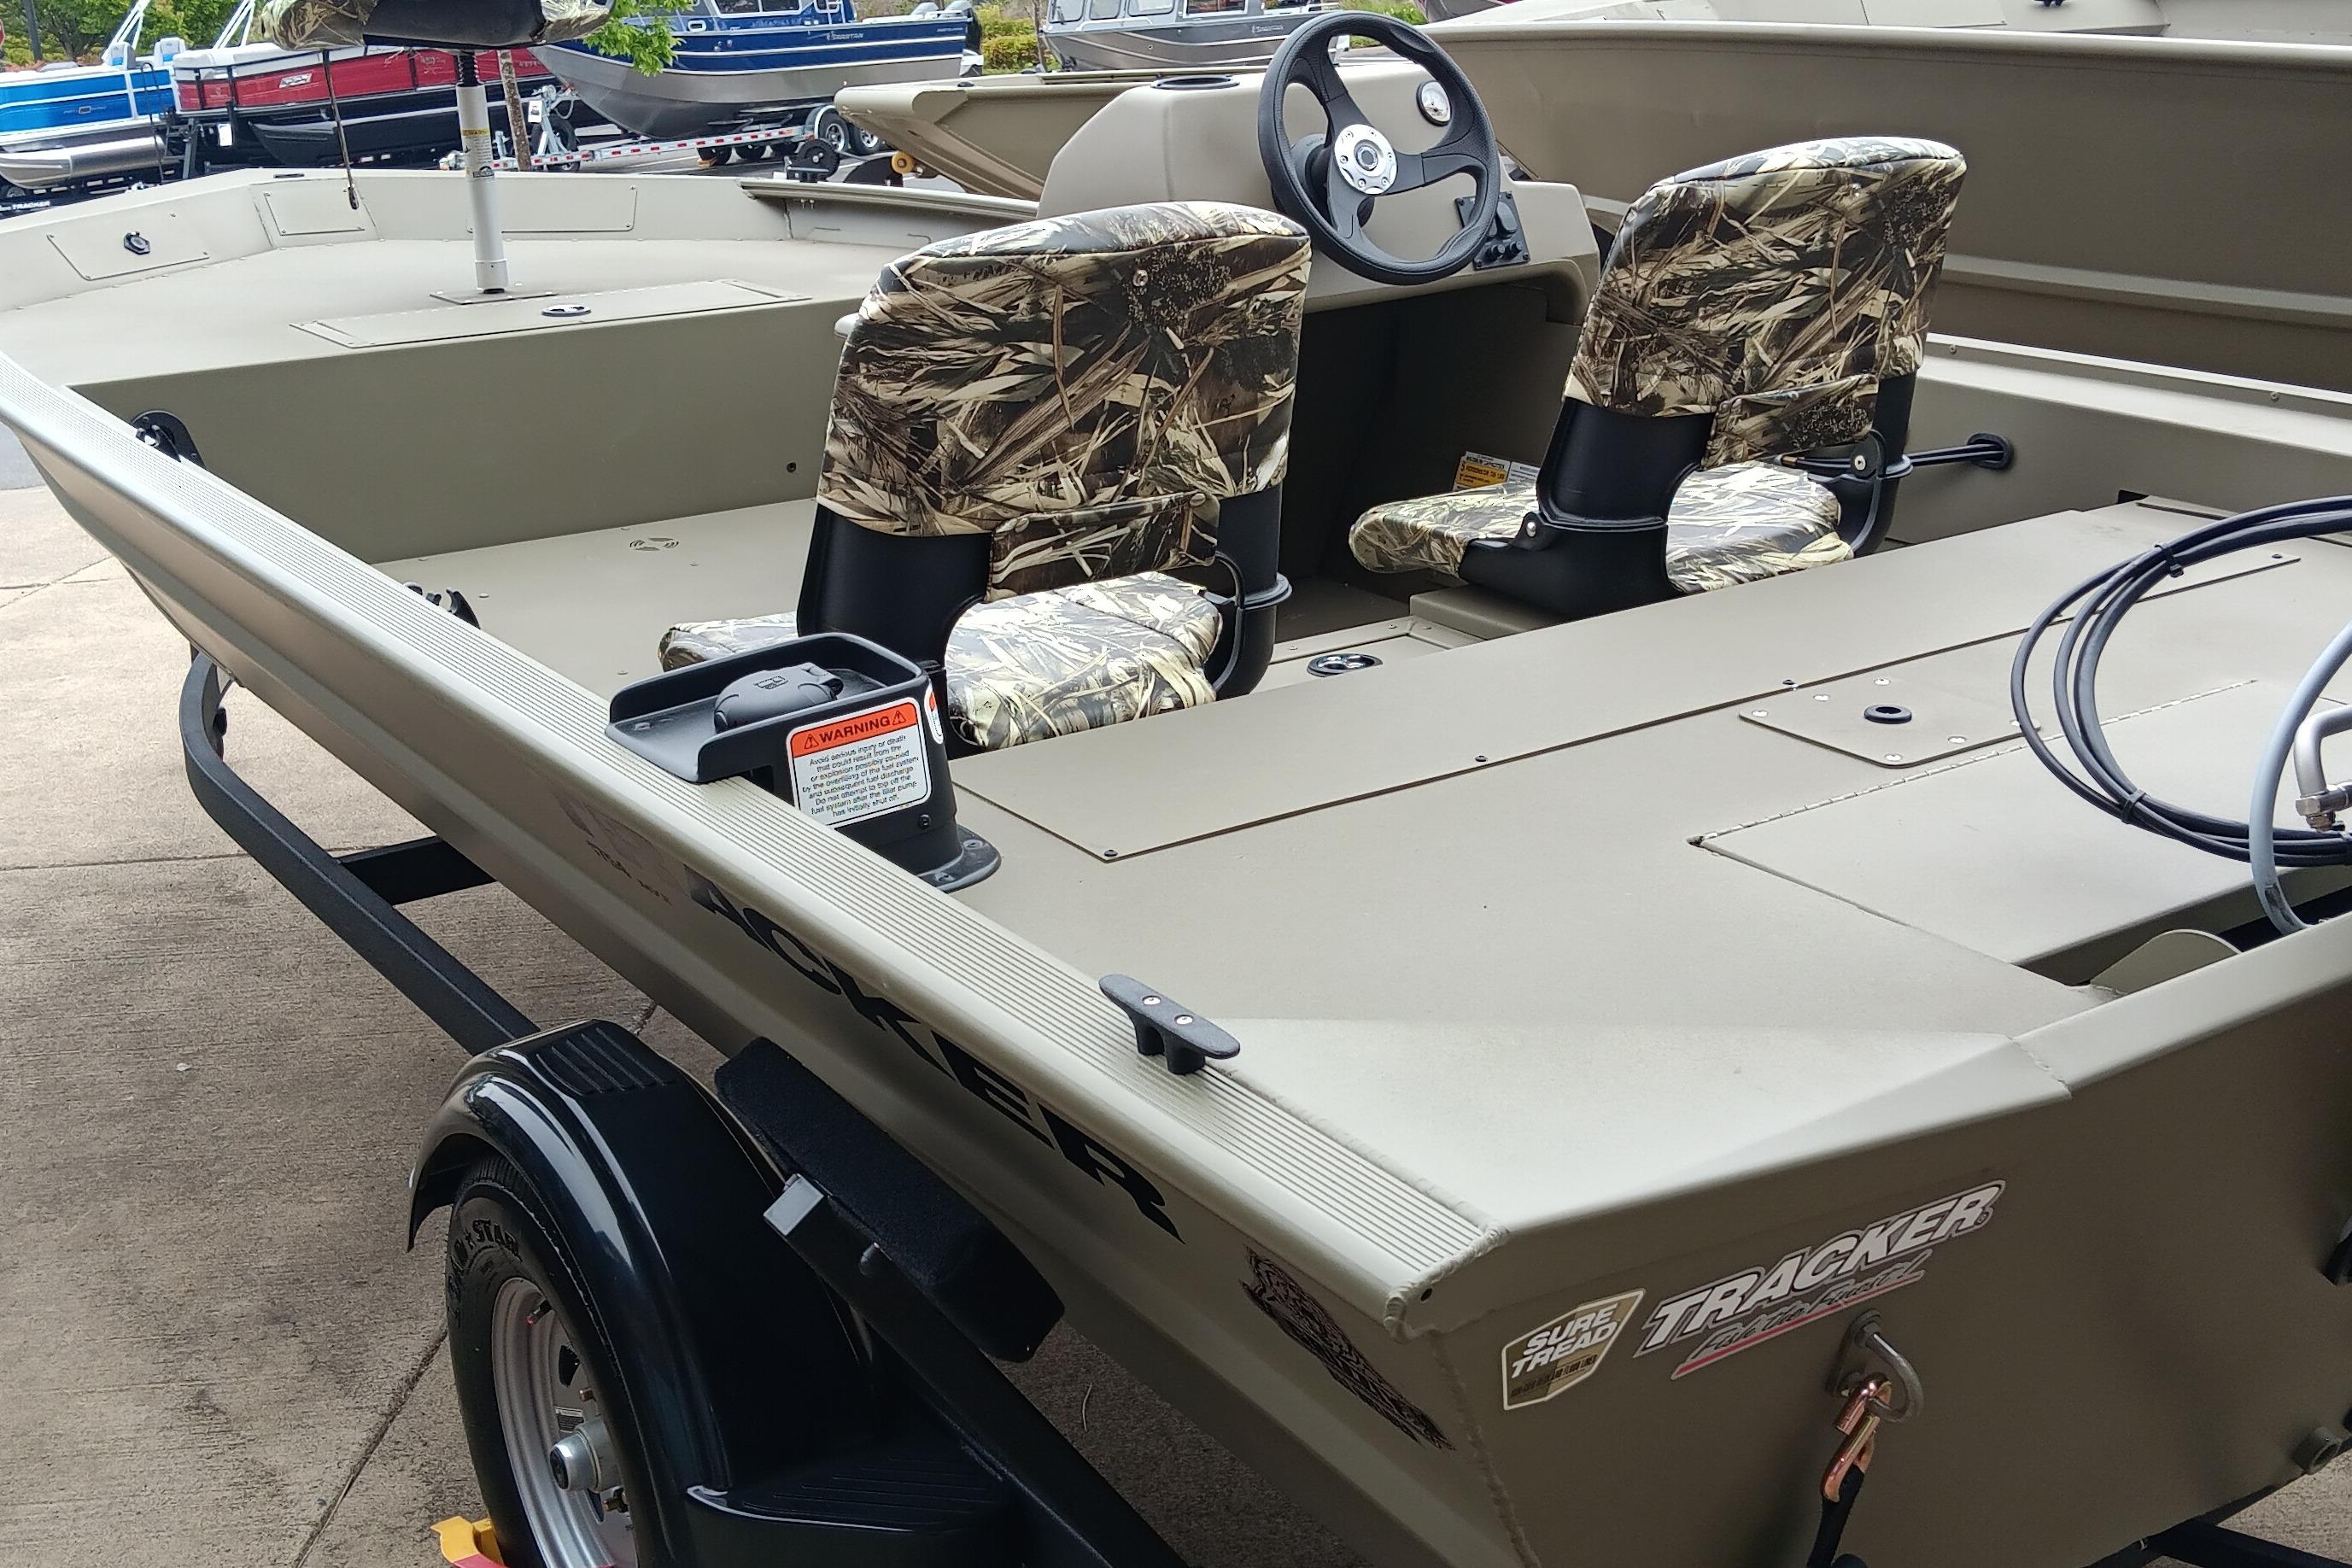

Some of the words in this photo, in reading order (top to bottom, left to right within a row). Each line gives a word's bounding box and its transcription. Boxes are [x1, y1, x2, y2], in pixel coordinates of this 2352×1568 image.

[819, 716, 891, 743] WARNING
[1511, 1321, 1617, 1378] TREAD
[1523, 1302, 1618, 1355] SURE
